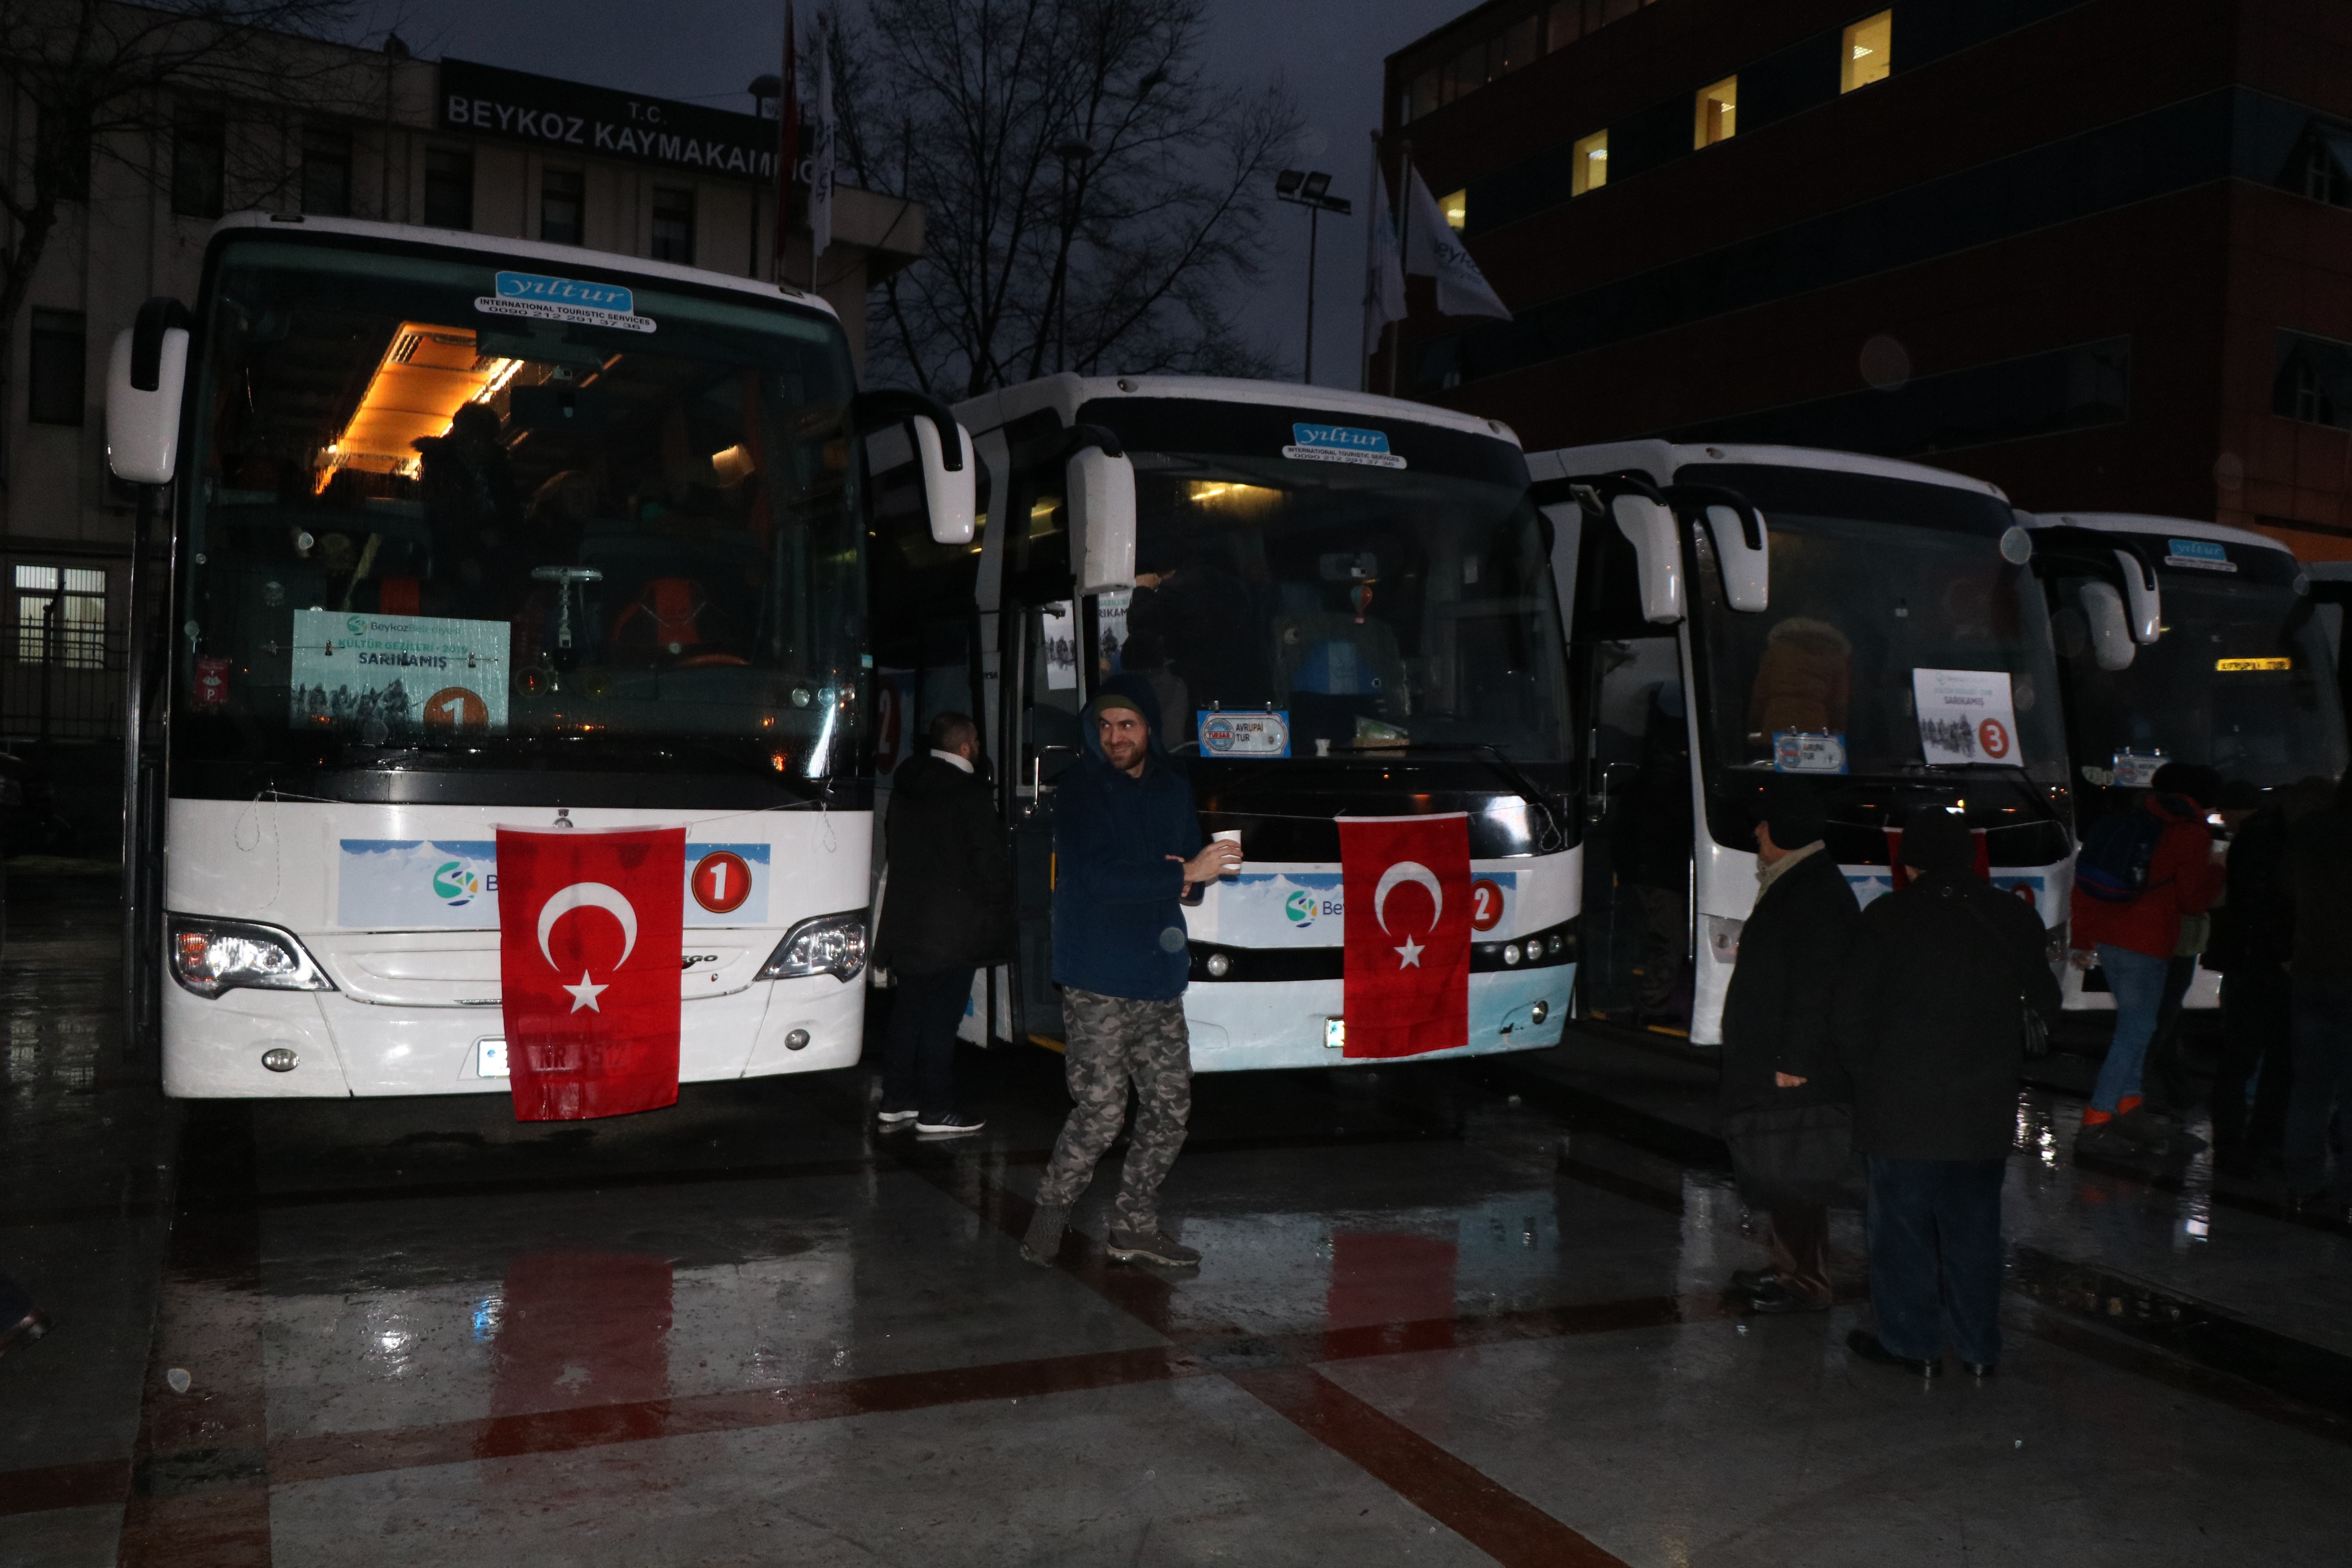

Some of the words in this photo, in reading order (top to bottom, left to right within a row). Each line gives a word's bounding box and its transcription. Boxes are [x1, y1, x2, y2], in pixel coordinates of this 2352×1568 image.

[448, 95, 584, 144] BEYKOZ
[628, 102, 668, 125] T.C.
[480, 298, 554, 312] INTERNATIONAL
[557, 307, 605, 318] TOURISTIC
[608, 313, 650, 325] SERVICES
[489, 306, 528, 315] 0090
[533, 310, 561, 319] 212
[566, 314, 593, 323] 291
[599, 318, 617, 327] 37
[1288, 447, 1337, 455] INTERNATIONAL
[338, 638, 381, 649] KÜLTÜR
[441, 697, 464, 726] 1
[878, 688, 891, 754] 2
[1985, 724, 2004, 752] 3
[710, 862, 727, 900] 1
[1474, 887, 1490, 920] 2
